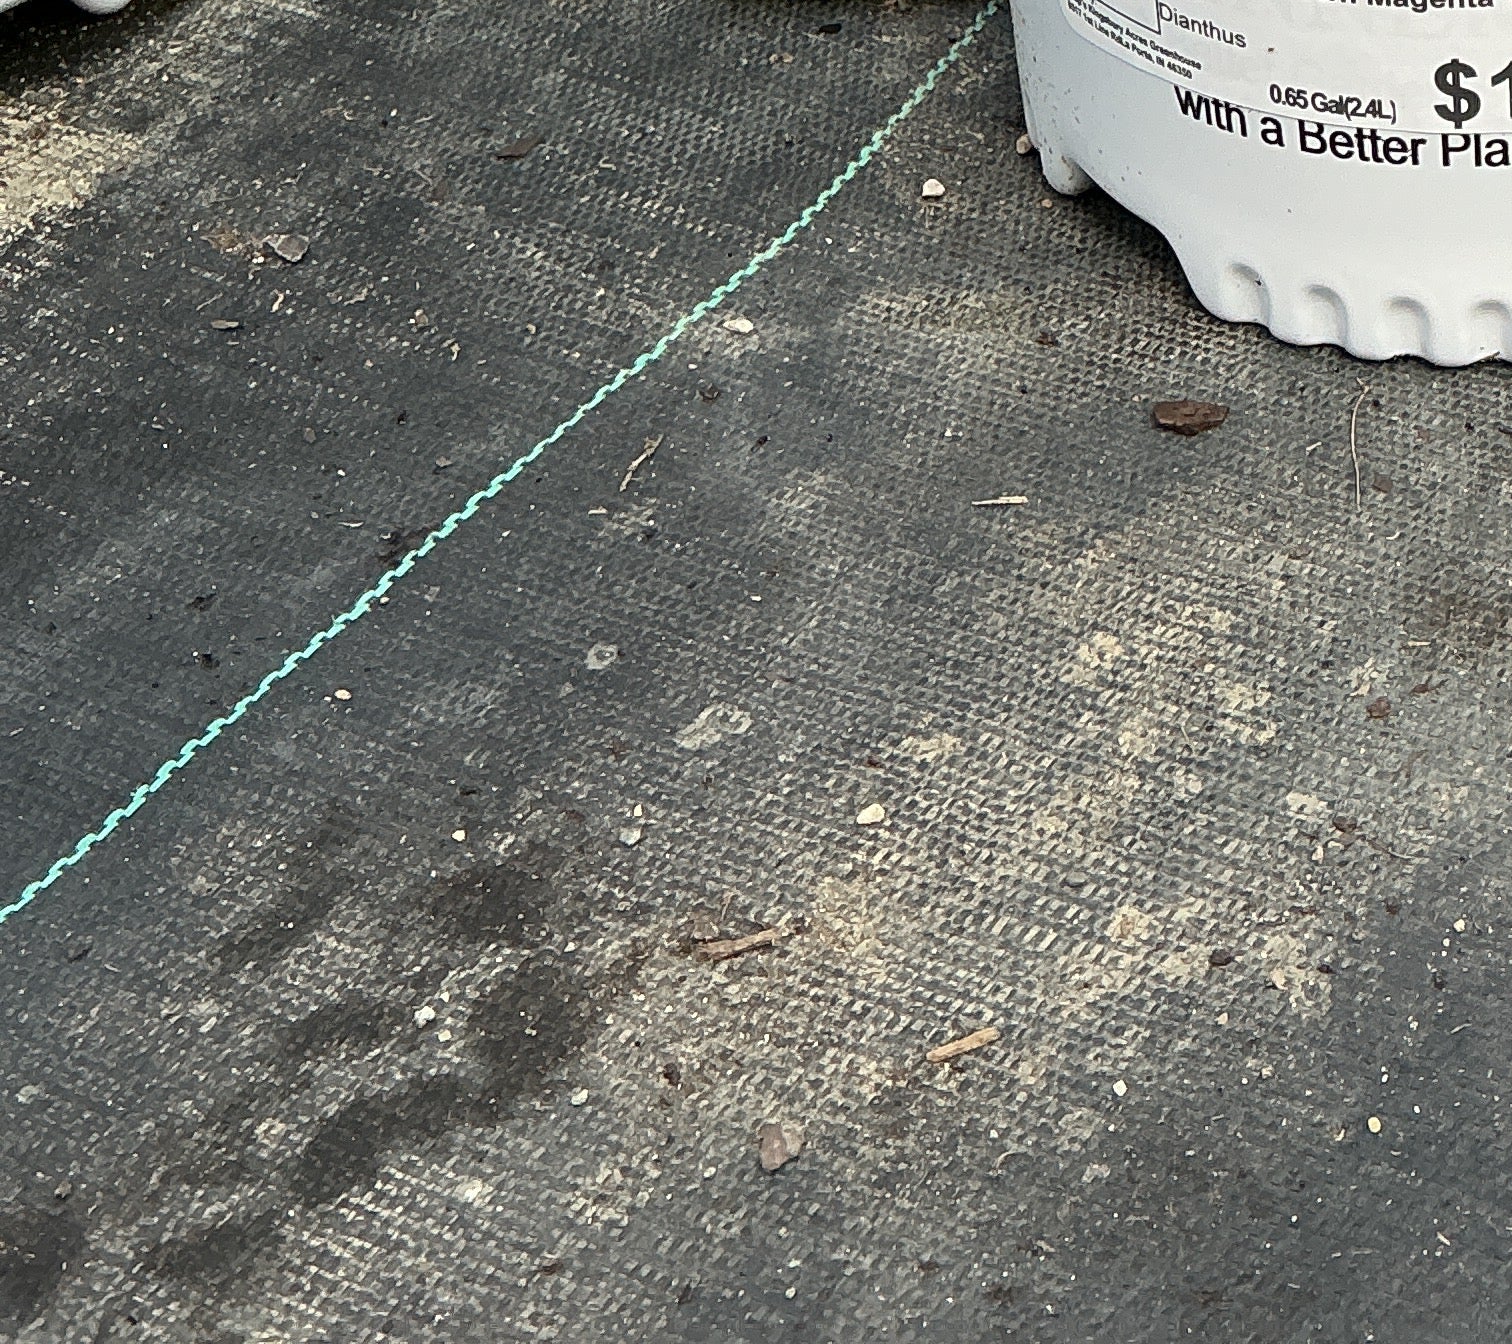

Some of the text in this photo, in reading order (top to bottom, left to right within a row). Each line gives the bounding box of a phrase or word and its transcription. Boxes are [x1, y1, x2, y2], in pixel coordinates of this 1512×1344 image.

[1157, 1, 1248, 49] Dianthus
[1269, 82, 1309, 111] 0.65
[1172, 84, 1249, 139] with
[1259, 115, 1286, 150] a
[1297, 117, 1428, 168] Better
